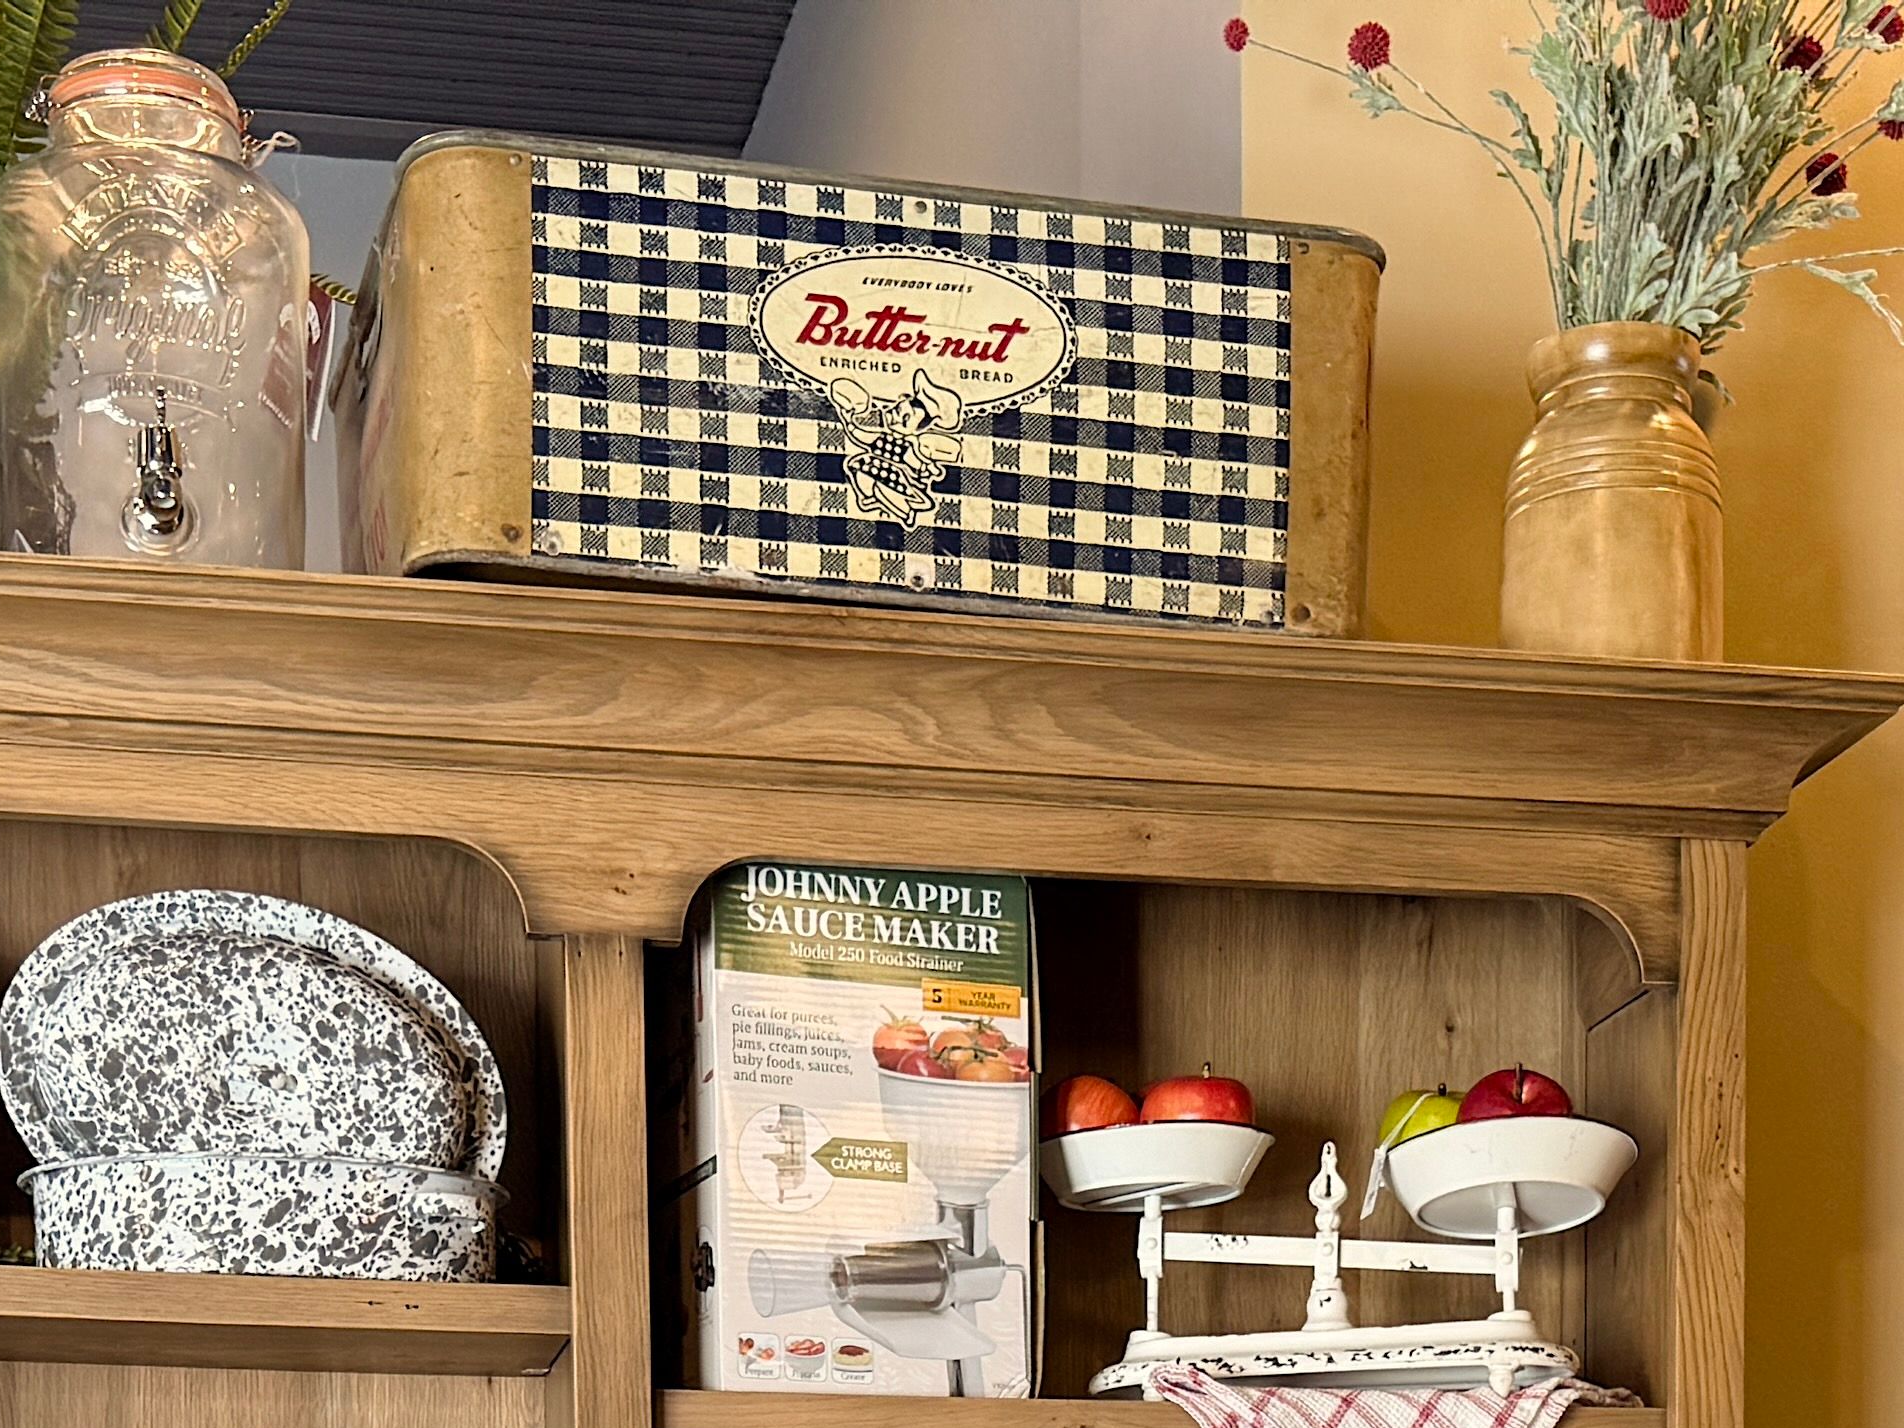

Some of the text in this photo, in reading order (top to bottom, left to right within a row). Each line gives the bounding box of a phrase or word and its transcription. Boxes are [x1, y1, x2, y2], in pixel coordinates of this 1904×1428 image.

[862, 276, 975, 294] EVERYBODY LOVES
[796, 293, 1031, 363] Butter-nut
[820, 356, 1014, 384] ENRICHED BREAD
[741, 865, 1002, 919] JOHNNY APPLE
[746, 903, 1000, 954] SAUCE MAKER
[789, 941, 964, 973] Model 250 Food Strainer
[931, 988, 943, 1004] 5
[958, 999, 1013, 1011] WARRANTY
[969, 991, 996, 1001] YEAR
[731, 1004, 767, 1018] Great
[770, 1004, 788, 1020] for
[732, 1021, 752, 1040] pie
[754, 1021, 800, 1041] fillings,
[769, 1042, 807, 1055] cream
[810, 1044, 851, 1061] soups,
[733, 1052, 854, 1077] baby foods, sauces,
[733, 1069, 793, 1086] and more
[841, 1146, 892, 1160] STRONG
[831, 1157, 904, 1174] CLAMP BASE
